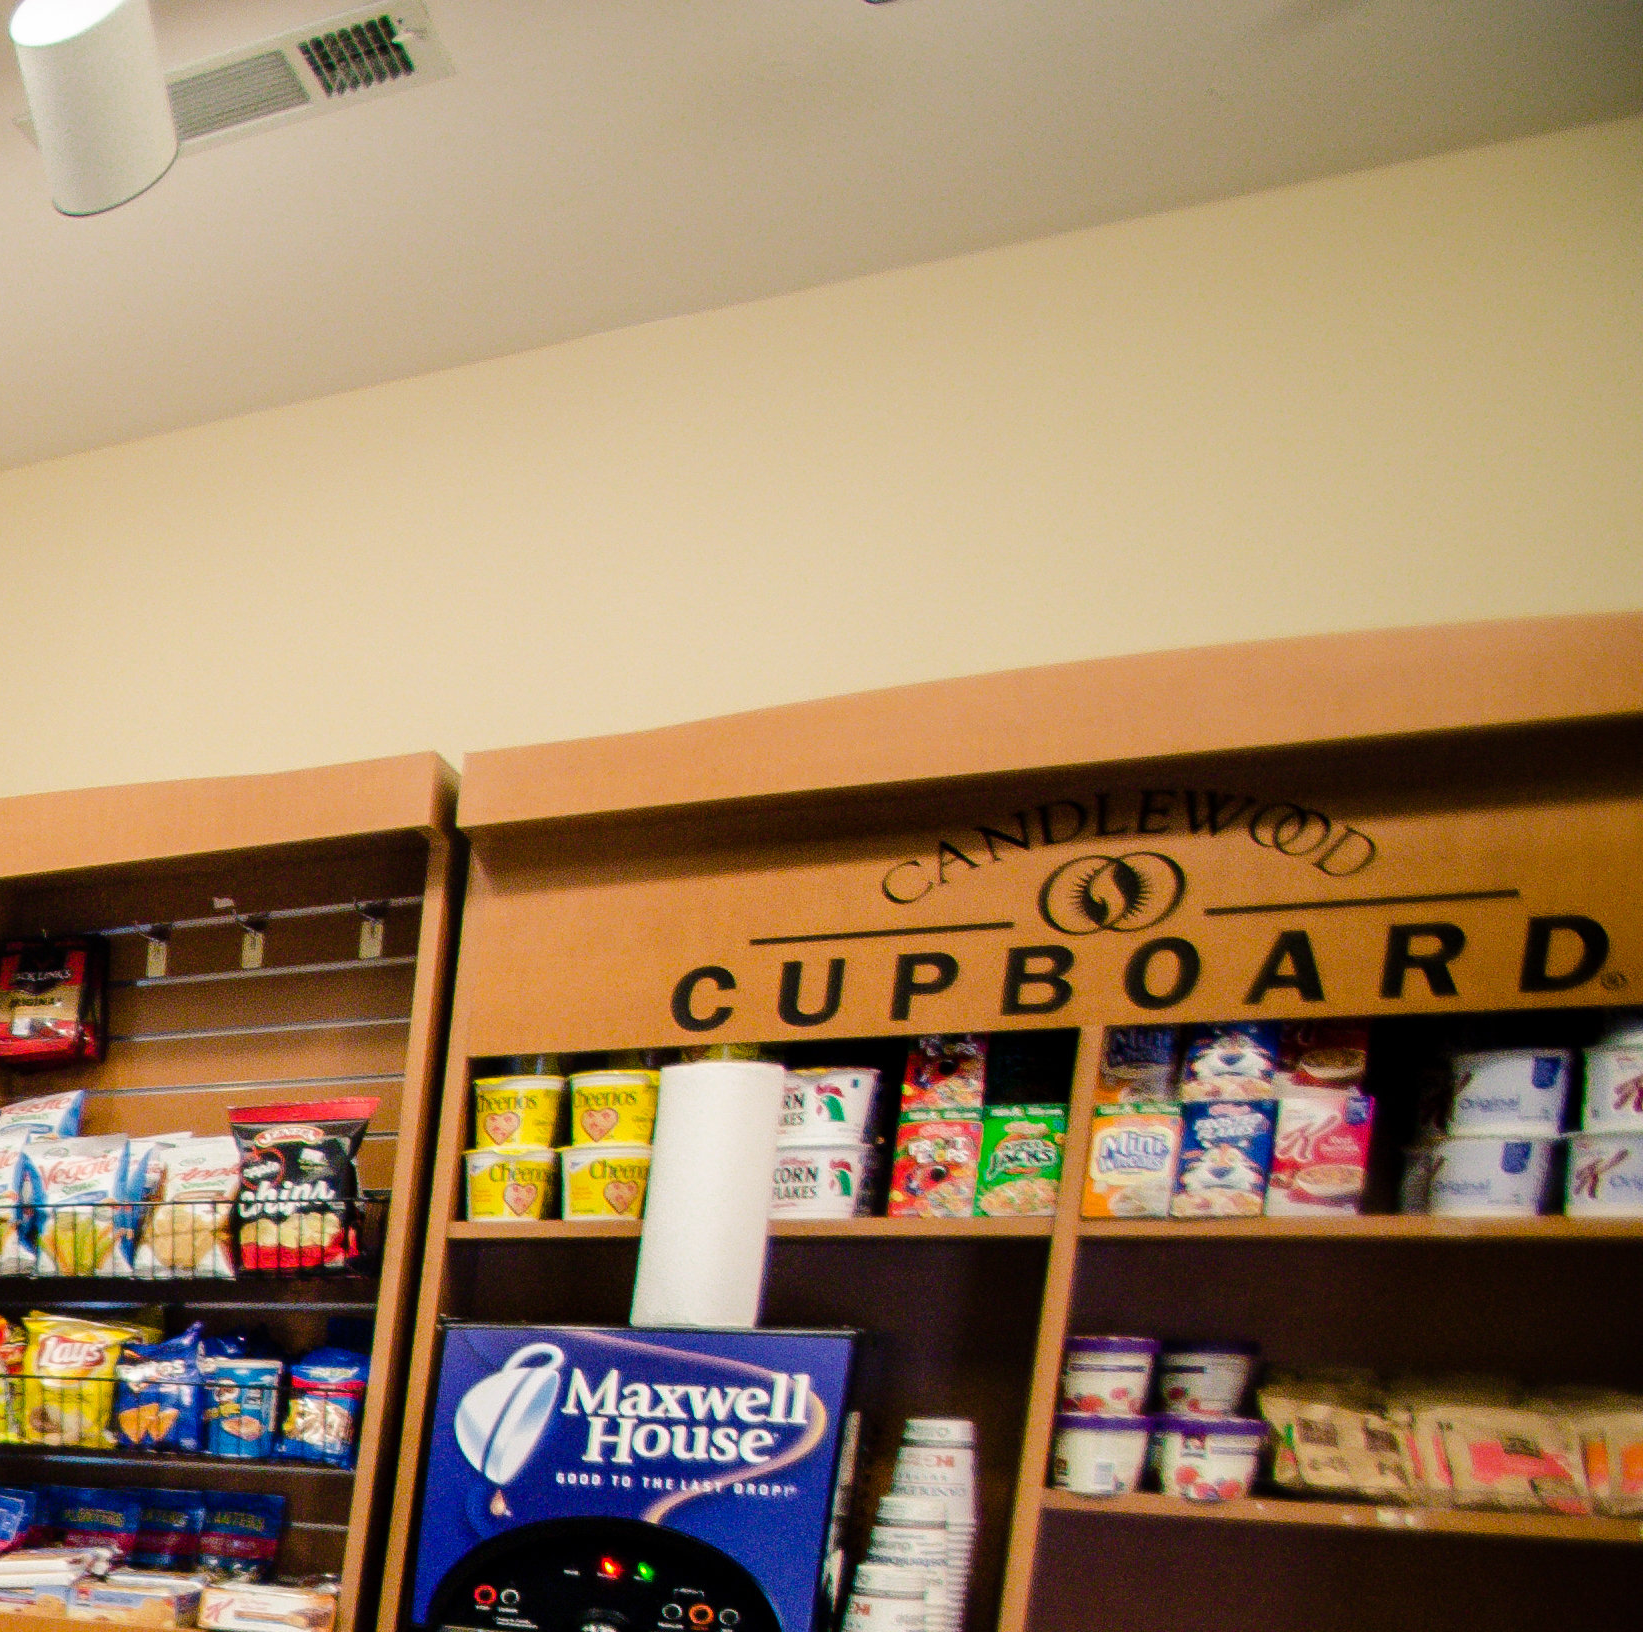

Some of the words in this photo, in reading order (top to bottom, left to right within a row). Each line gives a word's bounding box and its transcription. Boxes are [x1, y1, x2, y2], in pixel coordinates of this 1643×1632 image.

[882, 788, 1377, 904] CANDLEWOOD
[669, 912, 1612, 1032] CUPBOARD
[37, 1154, 115, 1191] Veggie
[773, 1166, 820, 1184] CORN
[561, 1367, 811, 1425] Maxwell
[581, 1416, 774, 1464] House
[555, 1471, 603, 1487] GOOD
[612, 1474, 633, 1489] TO
[642, 1476, 674, 1491] THE
[680, 1479, 723, 1494] LAST
